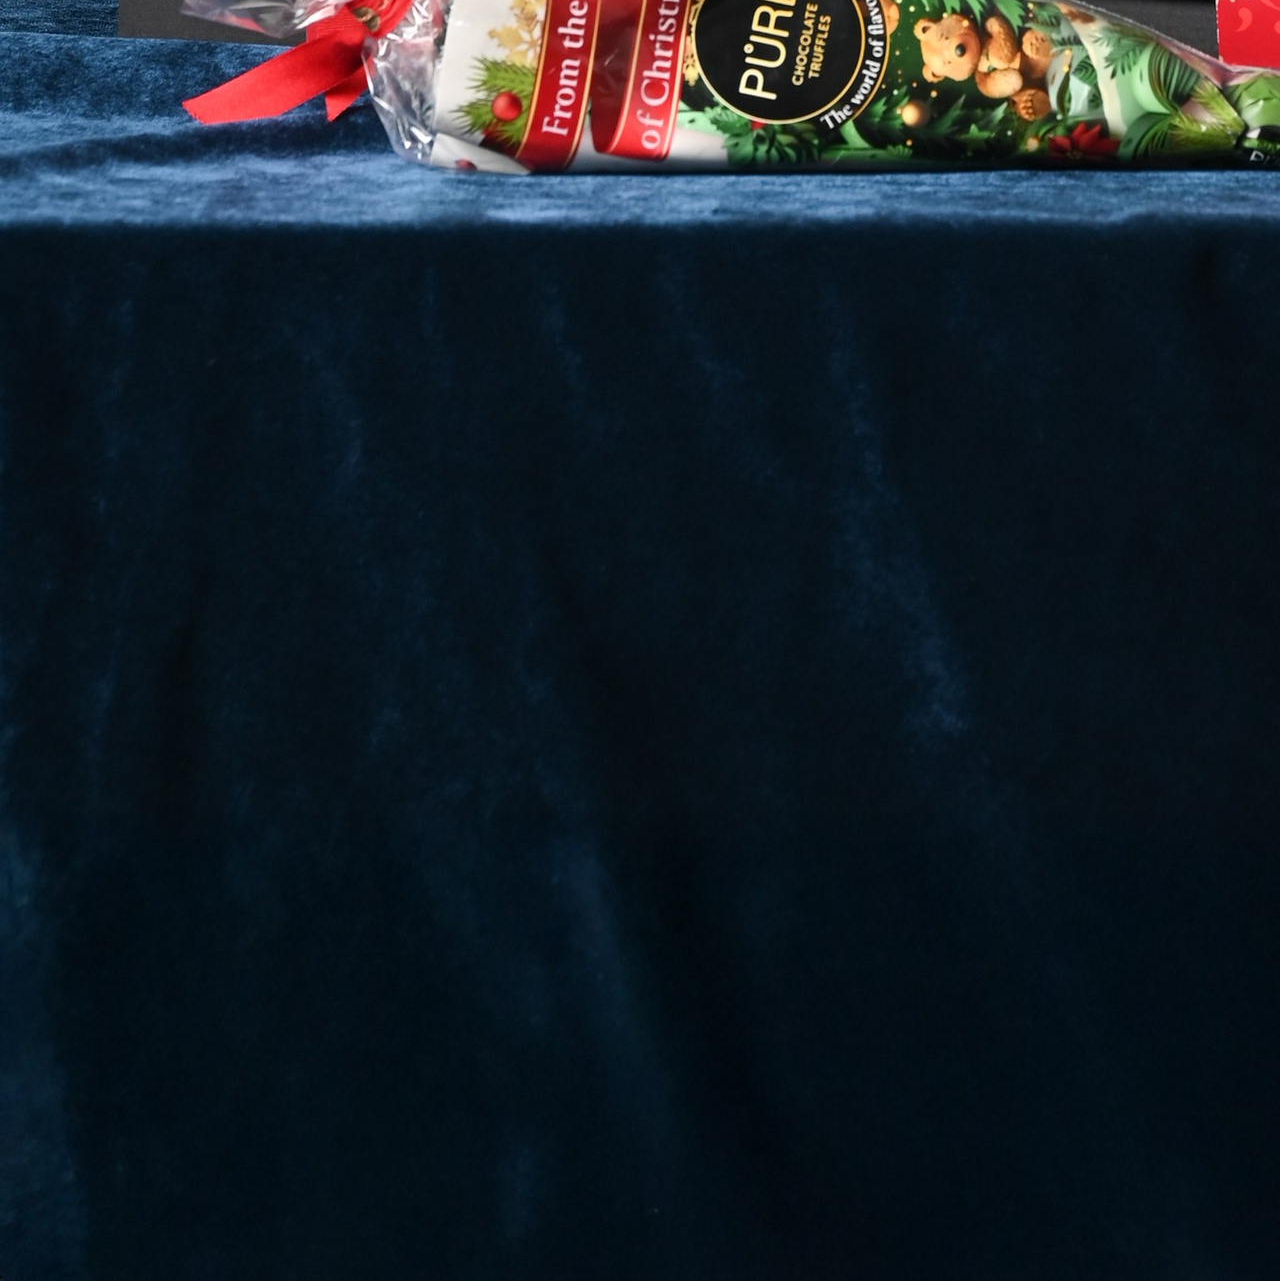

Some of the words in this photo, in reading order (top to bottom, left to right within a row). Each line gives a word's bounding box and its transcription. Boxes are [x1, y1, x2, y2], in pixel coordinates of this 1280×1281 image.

[557, 0, 588, 49] the
[791, 2, 819, 86] CHOCOLATE
[808, 15, 832, 79] TRUFFLES
[542, 59, 580, 136] From
[819, 104, 853, 130] The
[851, 59, 881, 105] world
[868, 38, 885, 58] of
[636, 110, 663, 150] of
